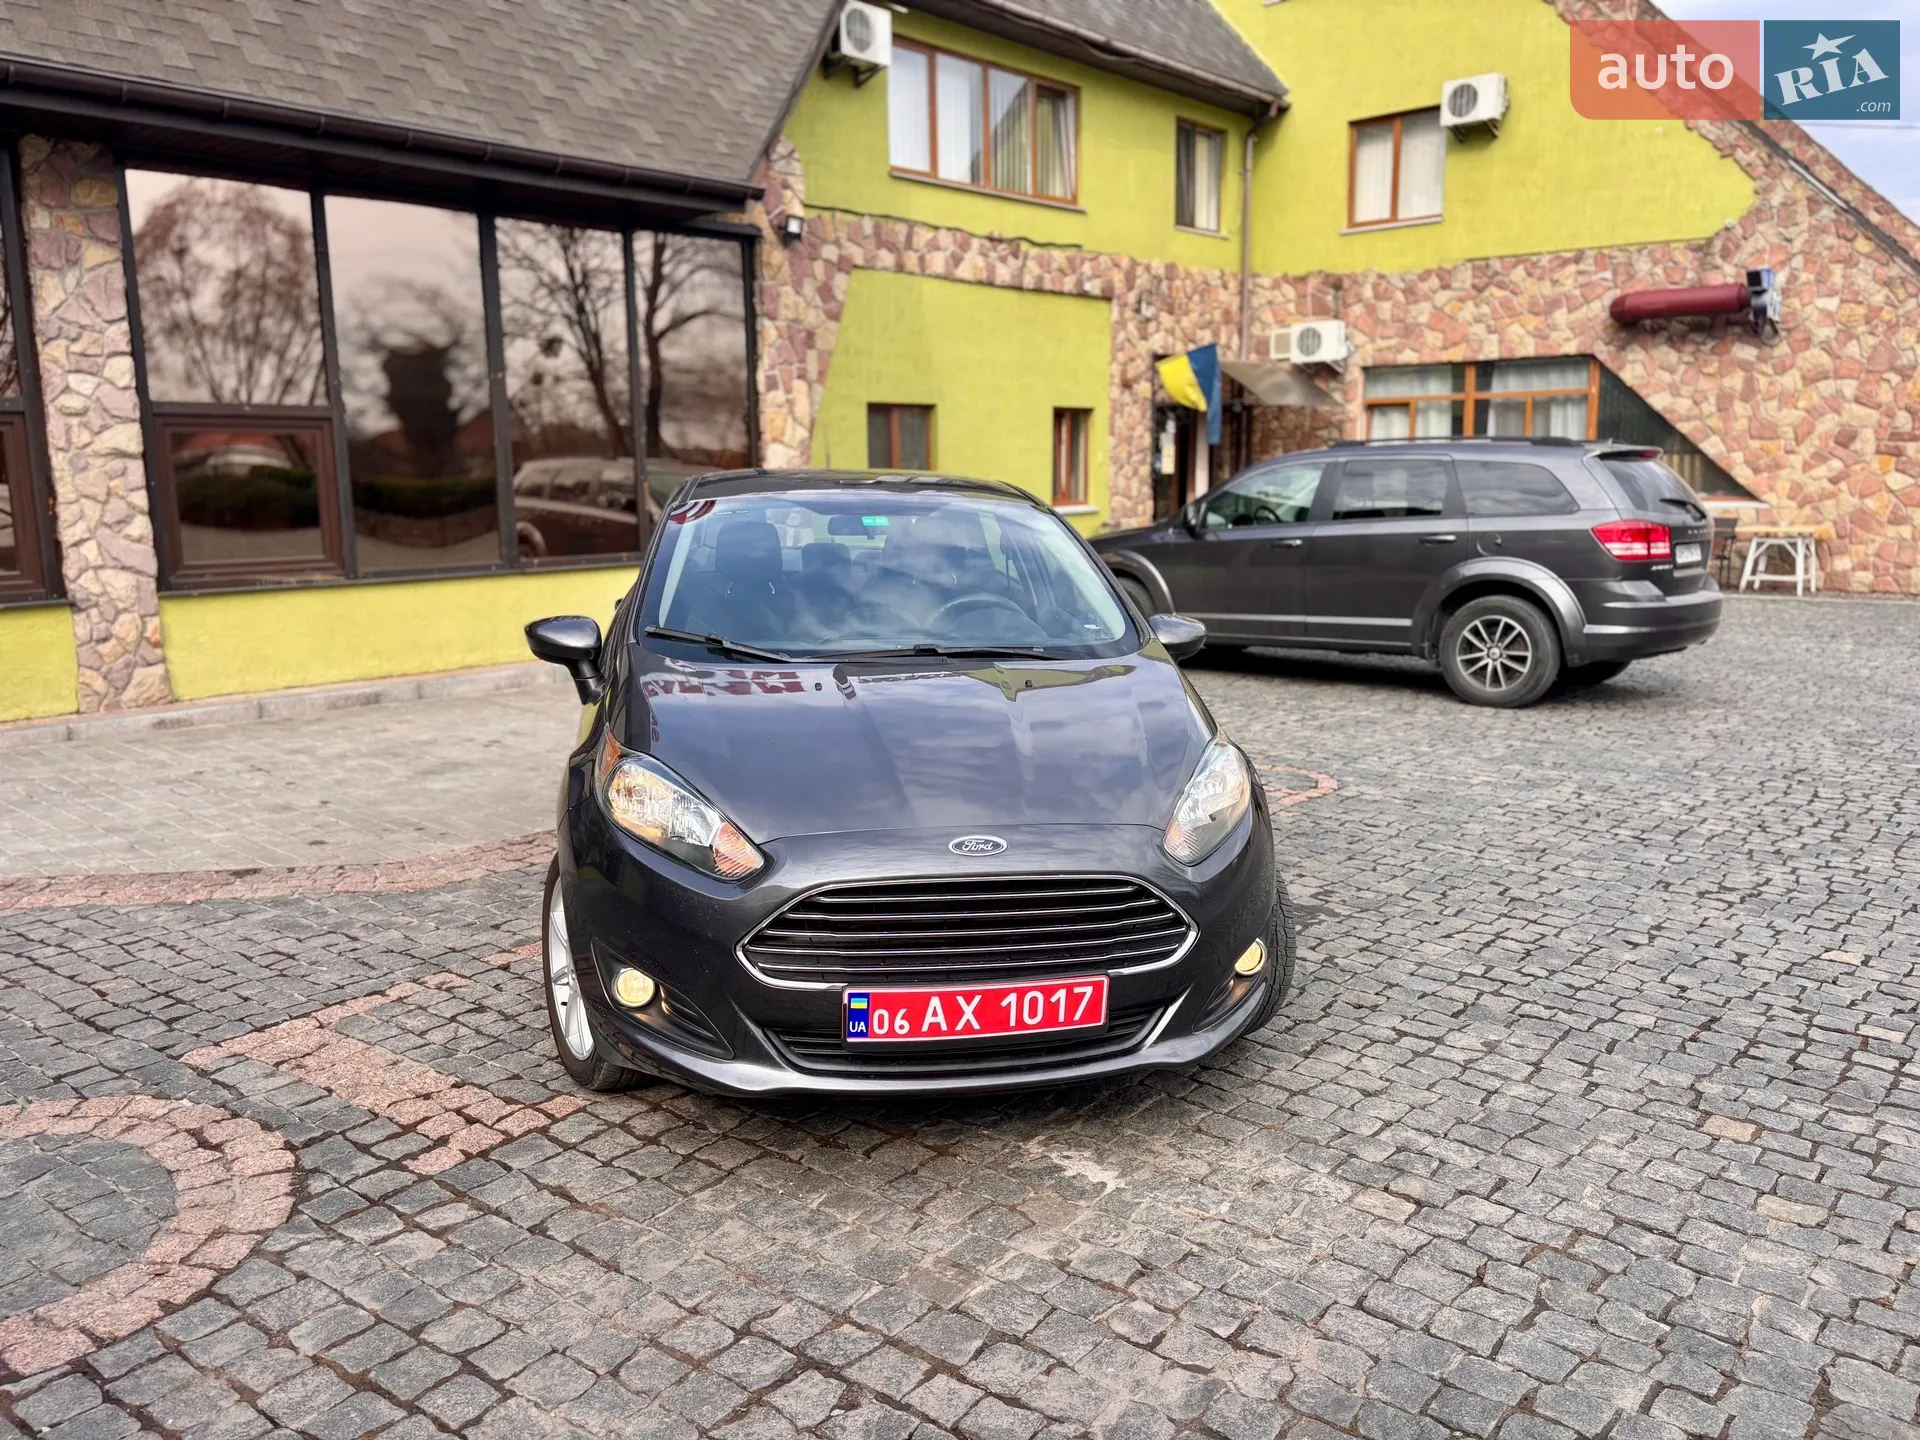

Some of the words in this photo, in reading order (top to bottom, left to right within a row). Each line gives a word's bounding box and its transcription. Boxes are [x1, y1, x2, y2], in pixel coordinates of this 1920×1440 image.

[962, 839, 994, 851] Ford
[849, 1021, 866, 1033] UA
[872, 1008, 910, 1035] 06
[921, 995, 983, 1032] AX
[1000, 985, 1094, 1027] 1017
